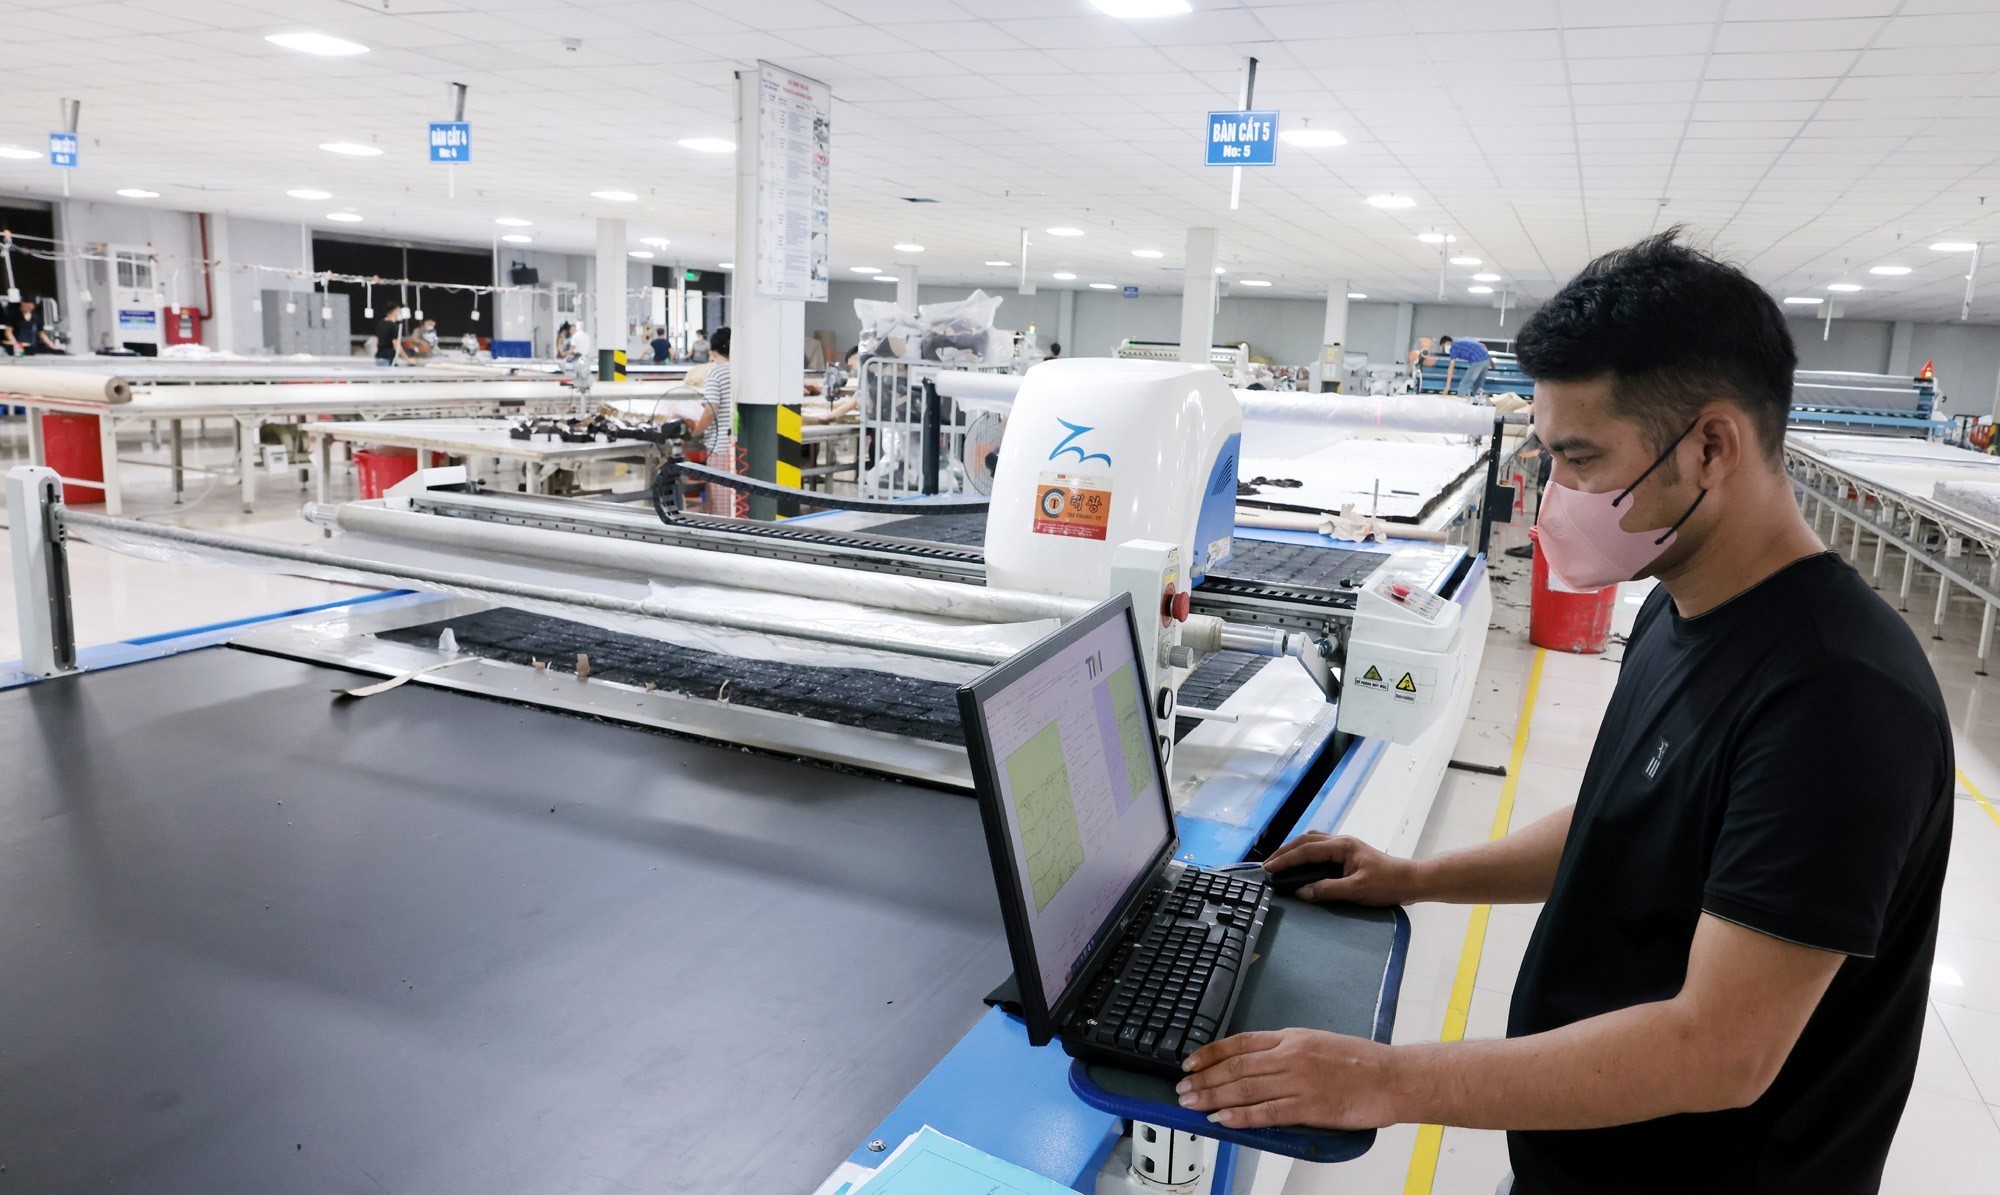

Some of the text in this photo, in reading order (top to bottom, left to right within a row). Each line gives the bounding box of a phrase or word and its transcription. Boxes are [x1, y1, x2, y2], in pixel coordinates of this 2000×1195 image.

[1213, 120, 1236, 142] BÀN
[1262, 122, 1270, 141] 5
[1223, 145, 1251, 157] No: 5
